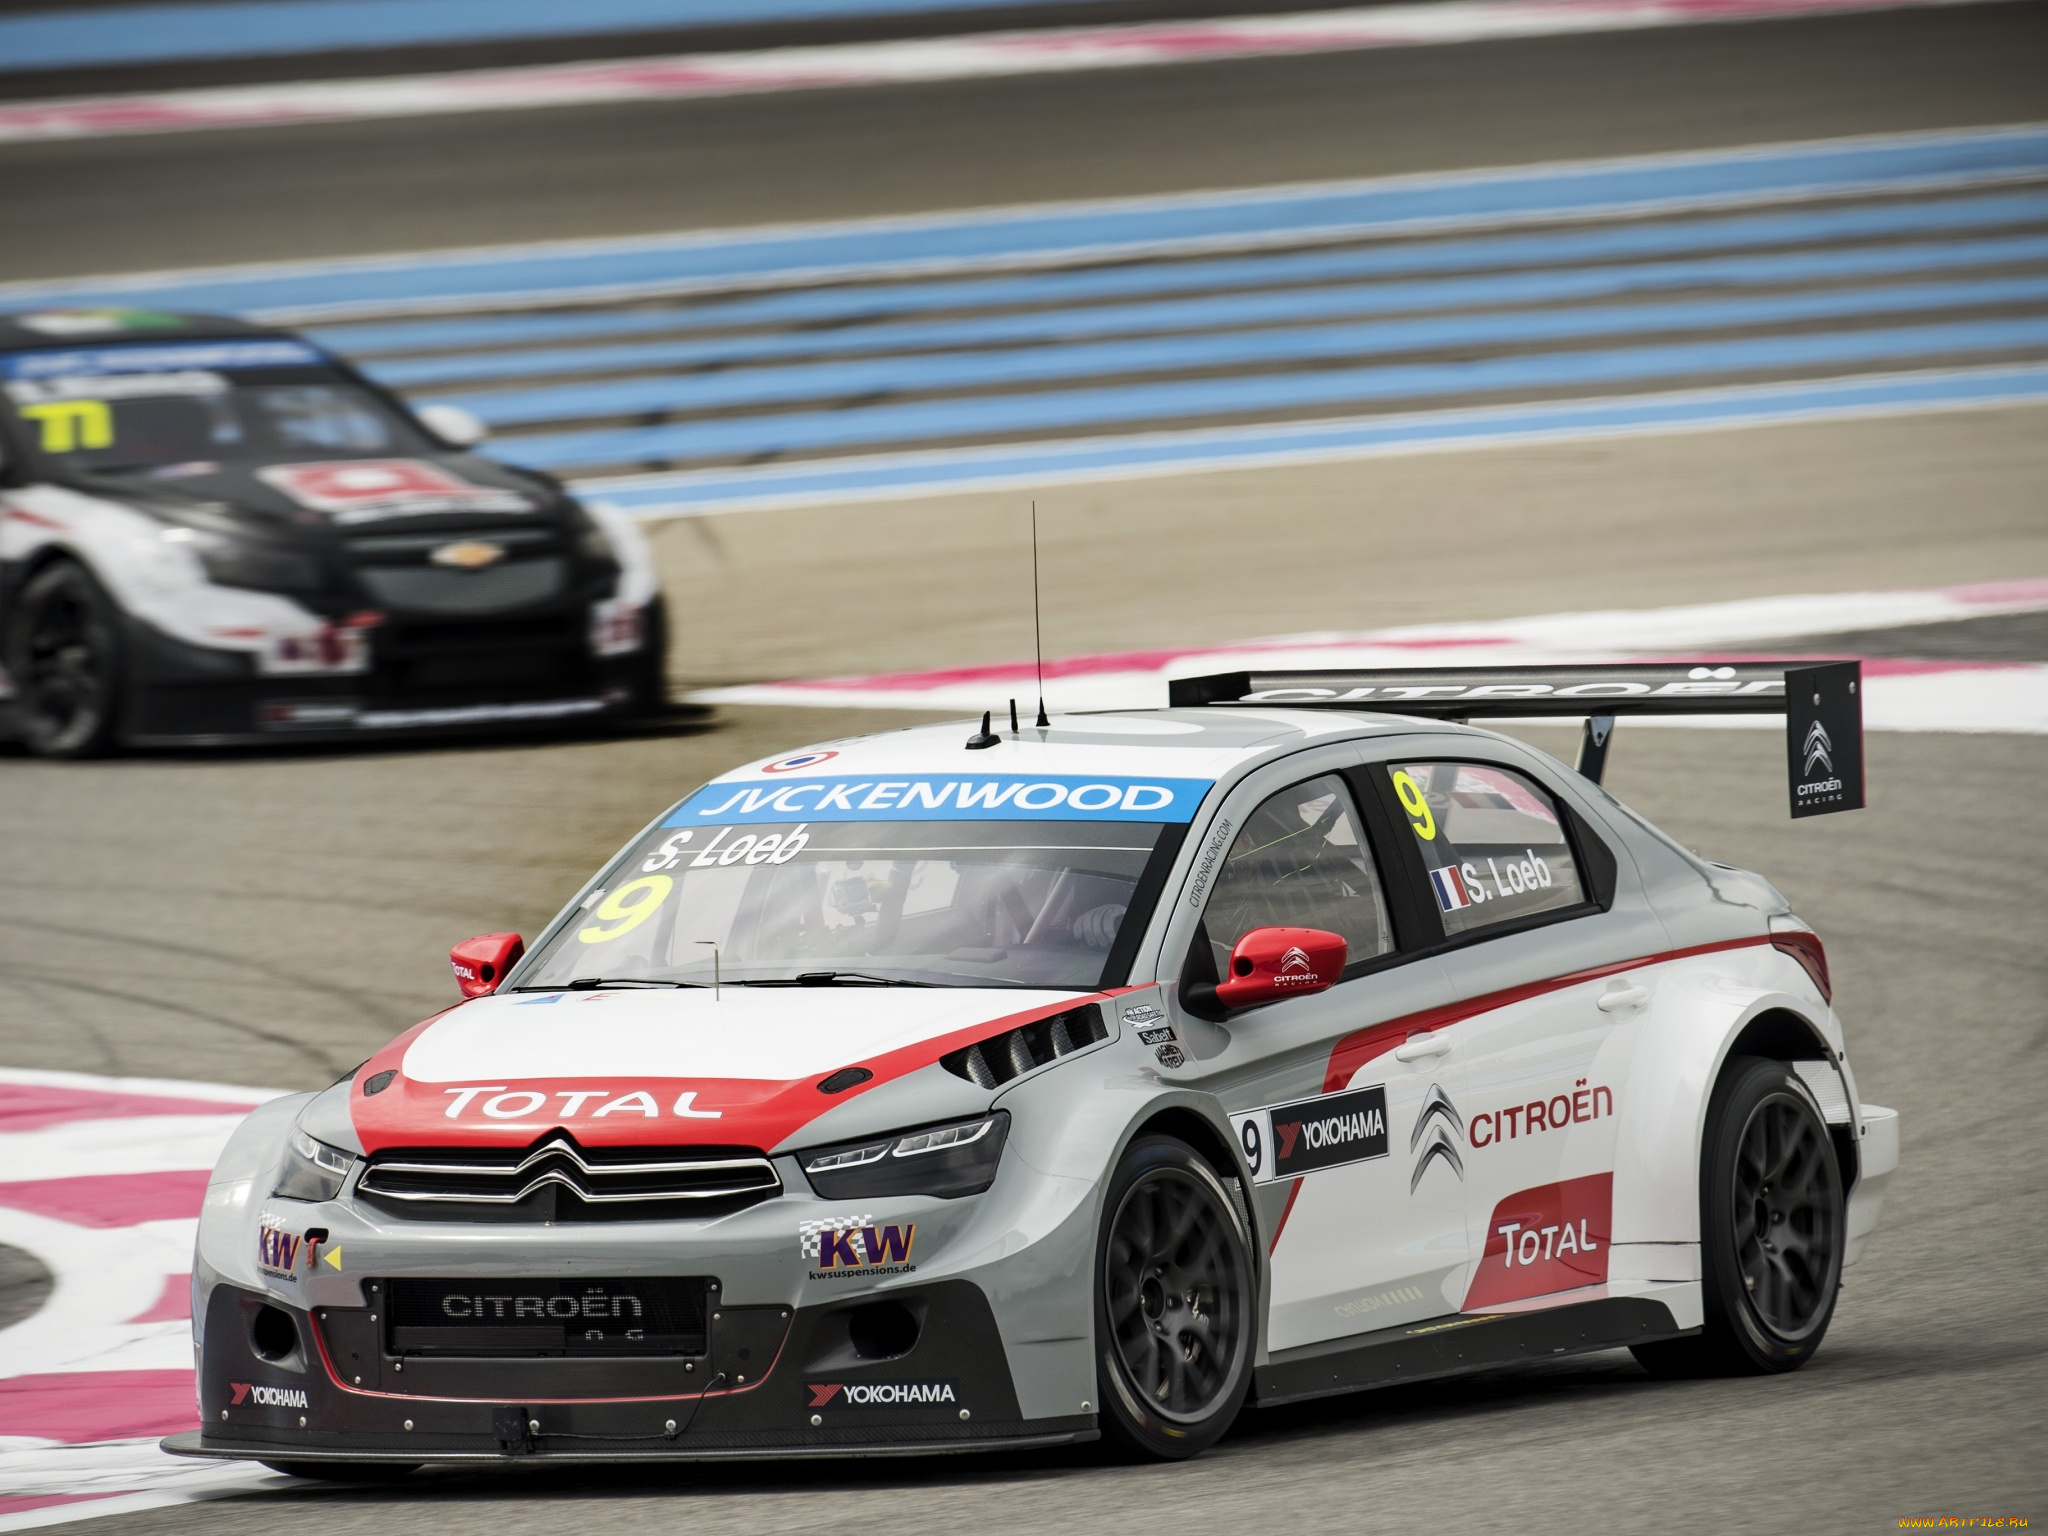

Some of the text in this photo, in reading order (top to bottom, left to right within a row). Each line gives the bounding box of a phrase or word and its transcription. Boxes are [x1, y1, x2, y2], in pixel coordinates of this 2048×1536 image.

[1392, 770, 1436, 841] 9
[642, 823, 810, 873] S. Loeb
[1189, 819, 1234, 908] CITROENRACING.COM
[1461, 849, 1552, 904] S. Loeb
[578, 874, 674, 944] 9
[451, 961, 475, 980] TOTAL
[1142, 1029, 1173, 1044] Sabelt
[443, 1086, 723, 1120] TOTAL
[1242, 1108, 1385, 1177] 9 YOKOHAMA
[258, 1225, 303, 1272] KW
[819, 1223, 916, 1270] KW
[1498, 1219, 1597, 1269] TOTAL
[809, 1263, 917, 1280] kwsuspensions.de
[251, 1386, 308, 1409] YOKOHAMA
[843, 1384, 956, 1403] YOKOHAMA
